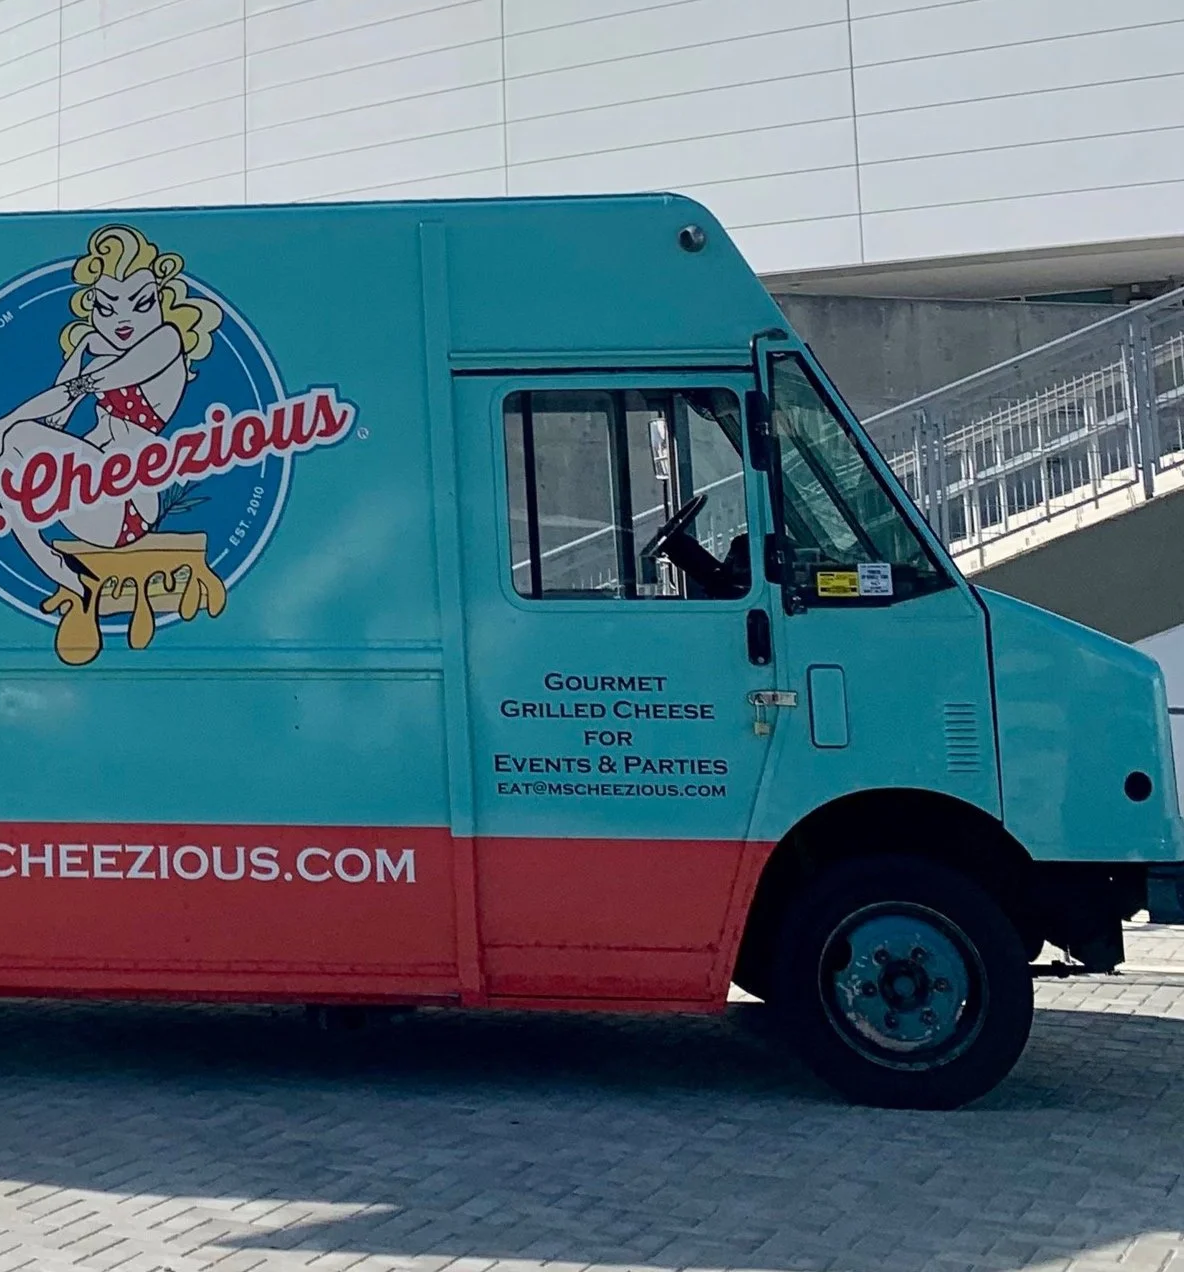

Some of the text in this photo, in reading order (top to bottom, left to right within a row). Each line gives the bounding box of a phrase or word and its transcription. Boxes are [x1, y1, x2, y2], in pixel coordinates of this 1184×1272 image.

[1, 394, 348, 523] Cheezious
[228, 486, 265, 547] EST. 2010
[597, 754, 617, 774] &
[497, 780, 727, 797] EAT@MSCHEEZIOUS.COM
